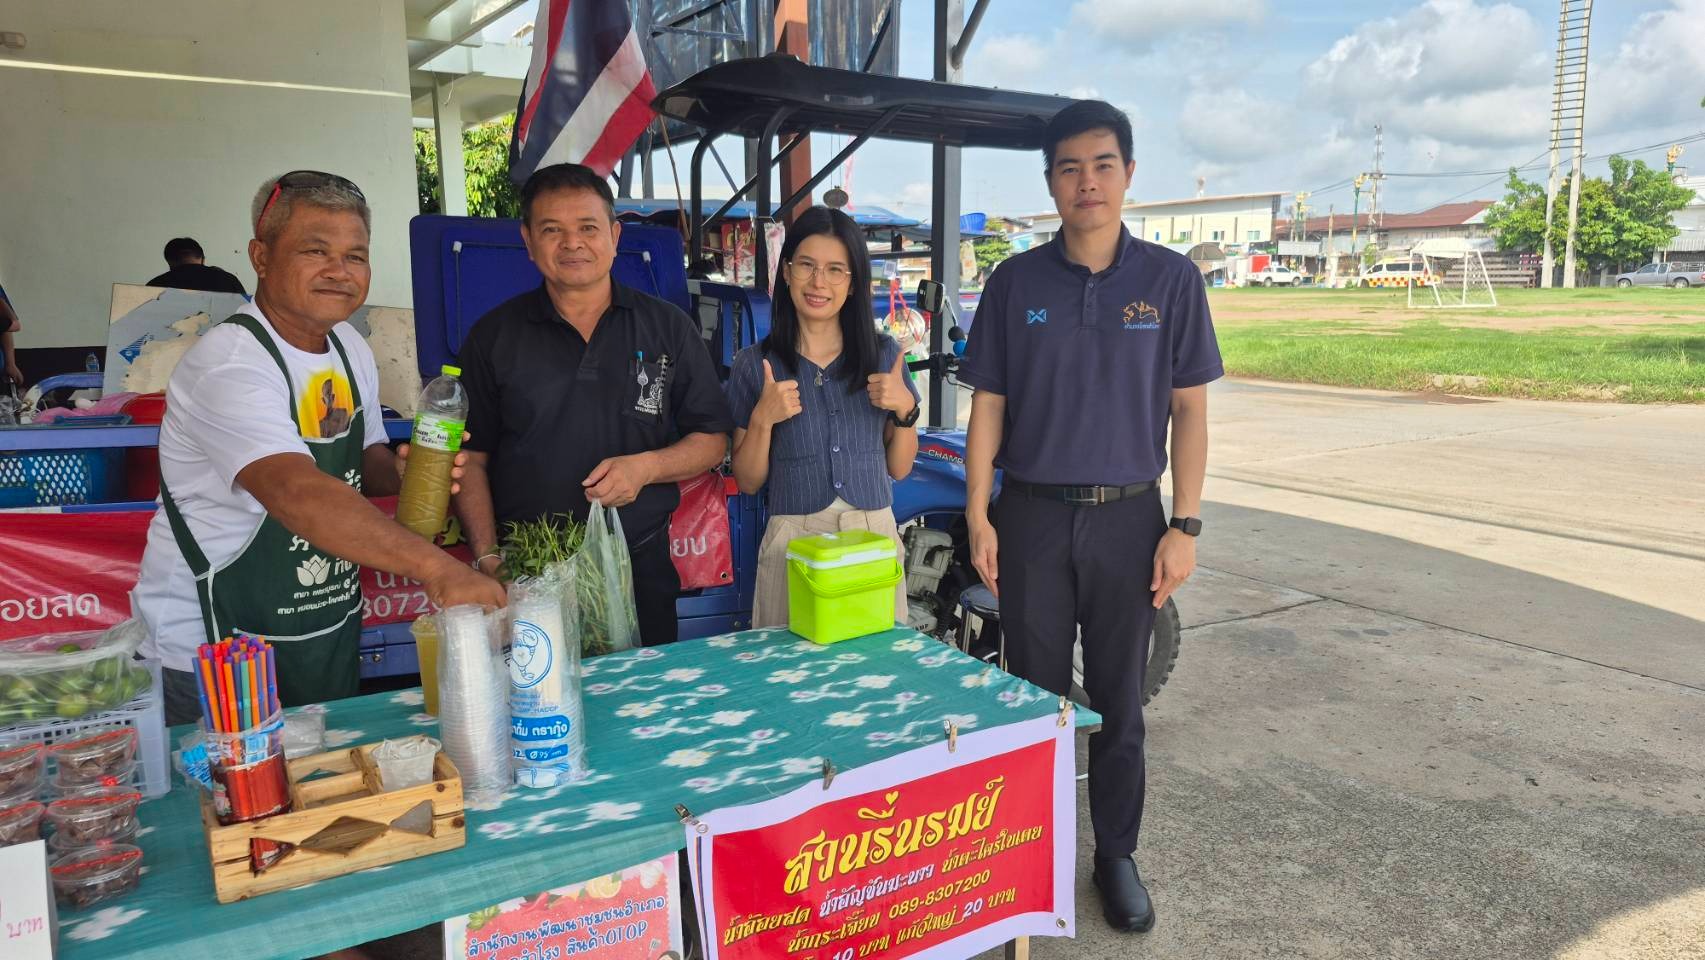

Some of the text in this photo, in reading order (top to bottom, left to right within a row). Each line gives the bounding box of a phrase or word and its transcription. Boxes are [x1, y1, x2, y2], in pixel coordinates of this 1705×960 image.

[362, 592, 442, 619] 3072
[783, 775, 1005, 895] สวนรื่นรมย์
[724, 826, 1043, 946] น้ำอ้อยสด น้ำอัญชันมะนาว น้ำตะไคร้ใบเตย
[788, 869, 991, 953] น้ำกระเจี๊ยบ 089-8307200
[859, 934, 891, 957] บาท
[963, 897, 983, 917] 20
[988, 887, 1017, 908] บาท
[468, 896, 666, 956] สำนักงานพัฒนาชุมชนอำเภอ
